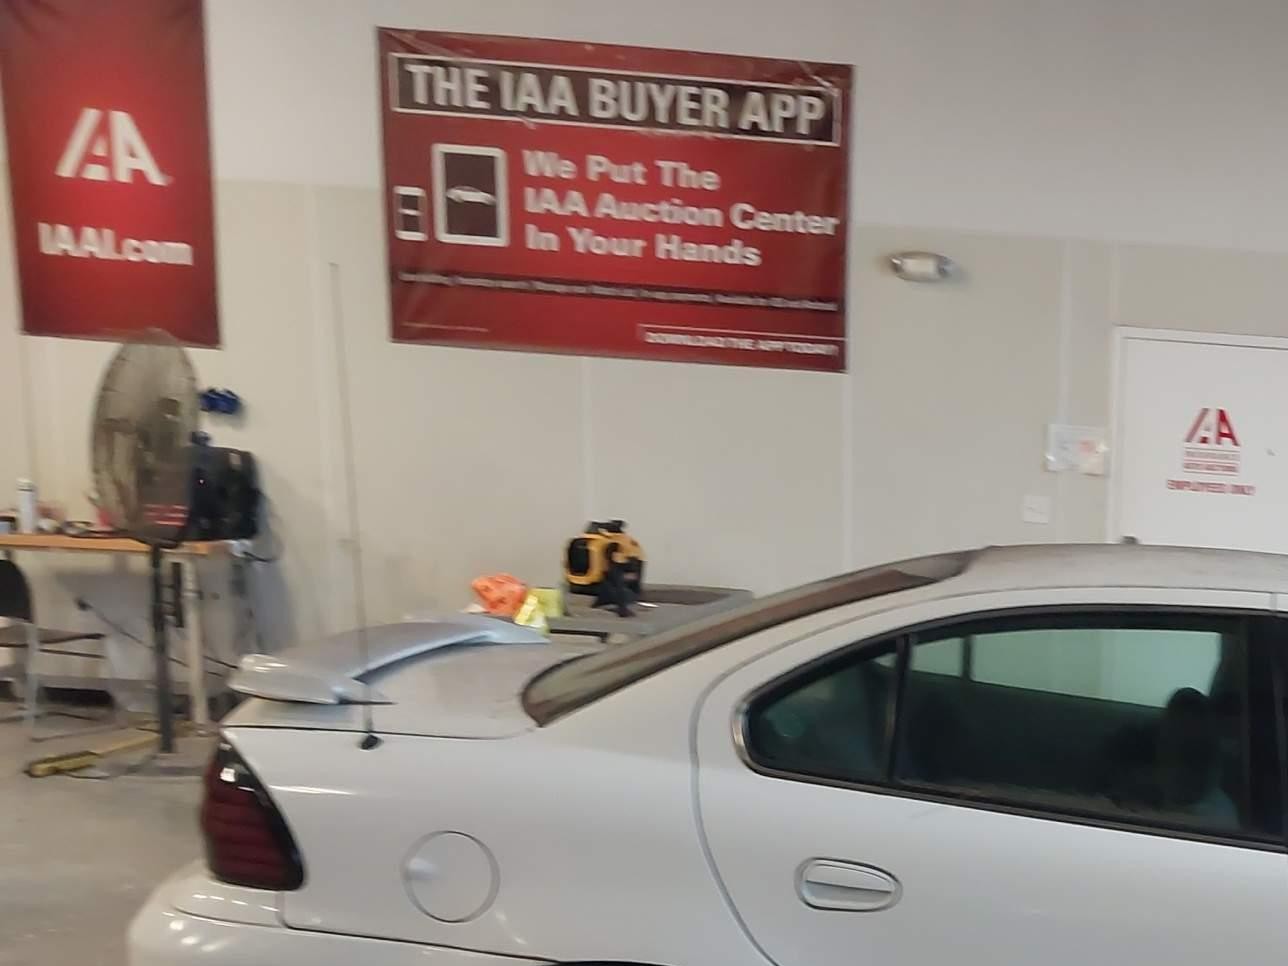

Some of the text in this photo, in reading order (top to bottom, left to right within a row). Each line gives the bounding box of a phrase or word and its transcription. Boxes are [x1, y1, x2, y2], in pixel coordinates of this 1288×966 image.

[405, 63, 826, 135] THE IAA BUYER APP
[522, 150, 721, 191] We Put The
[523, 186, 841, 236] IAA Auction Center
[525, 224, 762, 266] In Your Hands
